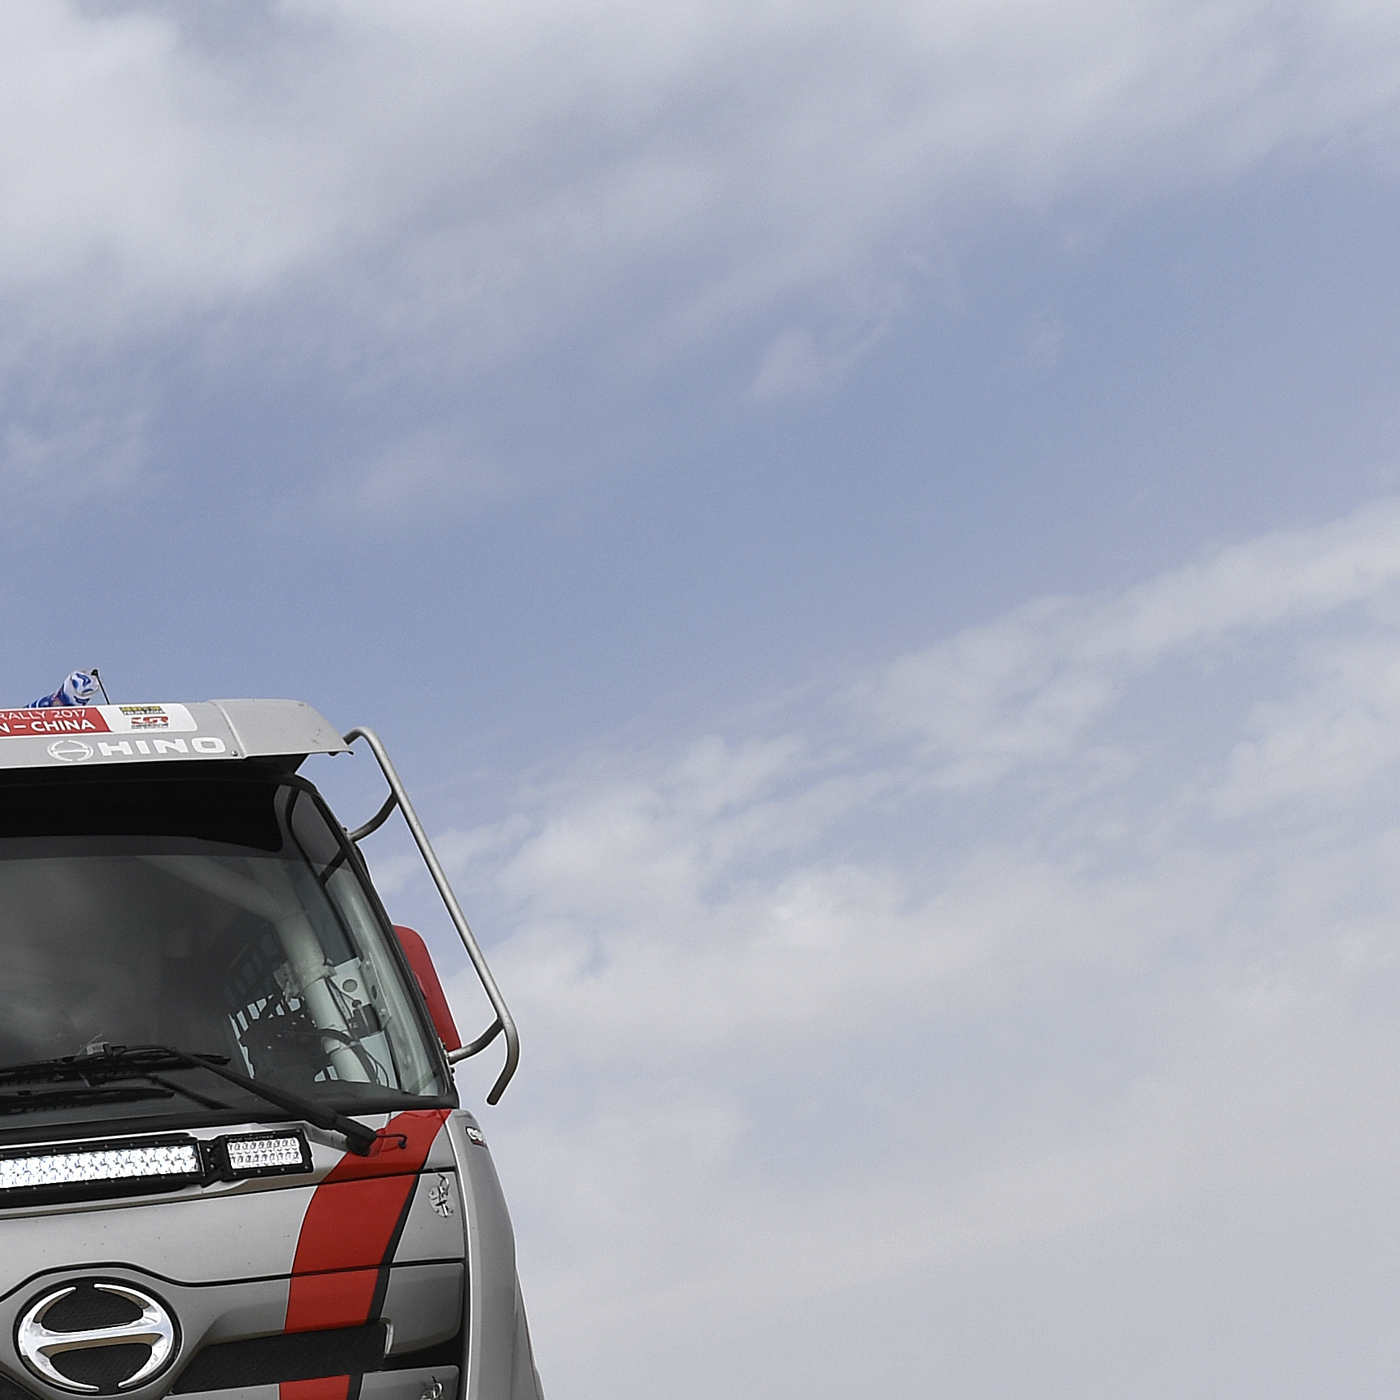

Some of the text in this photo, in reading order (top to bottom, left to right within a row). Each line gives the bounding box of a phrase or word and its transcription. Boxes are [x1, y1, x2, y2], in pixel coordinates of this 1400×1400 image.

[54, 709, 87, 719] 2017
[30, 719, 96, 733] CHINA
[97, 737, 227, 757] HINO
